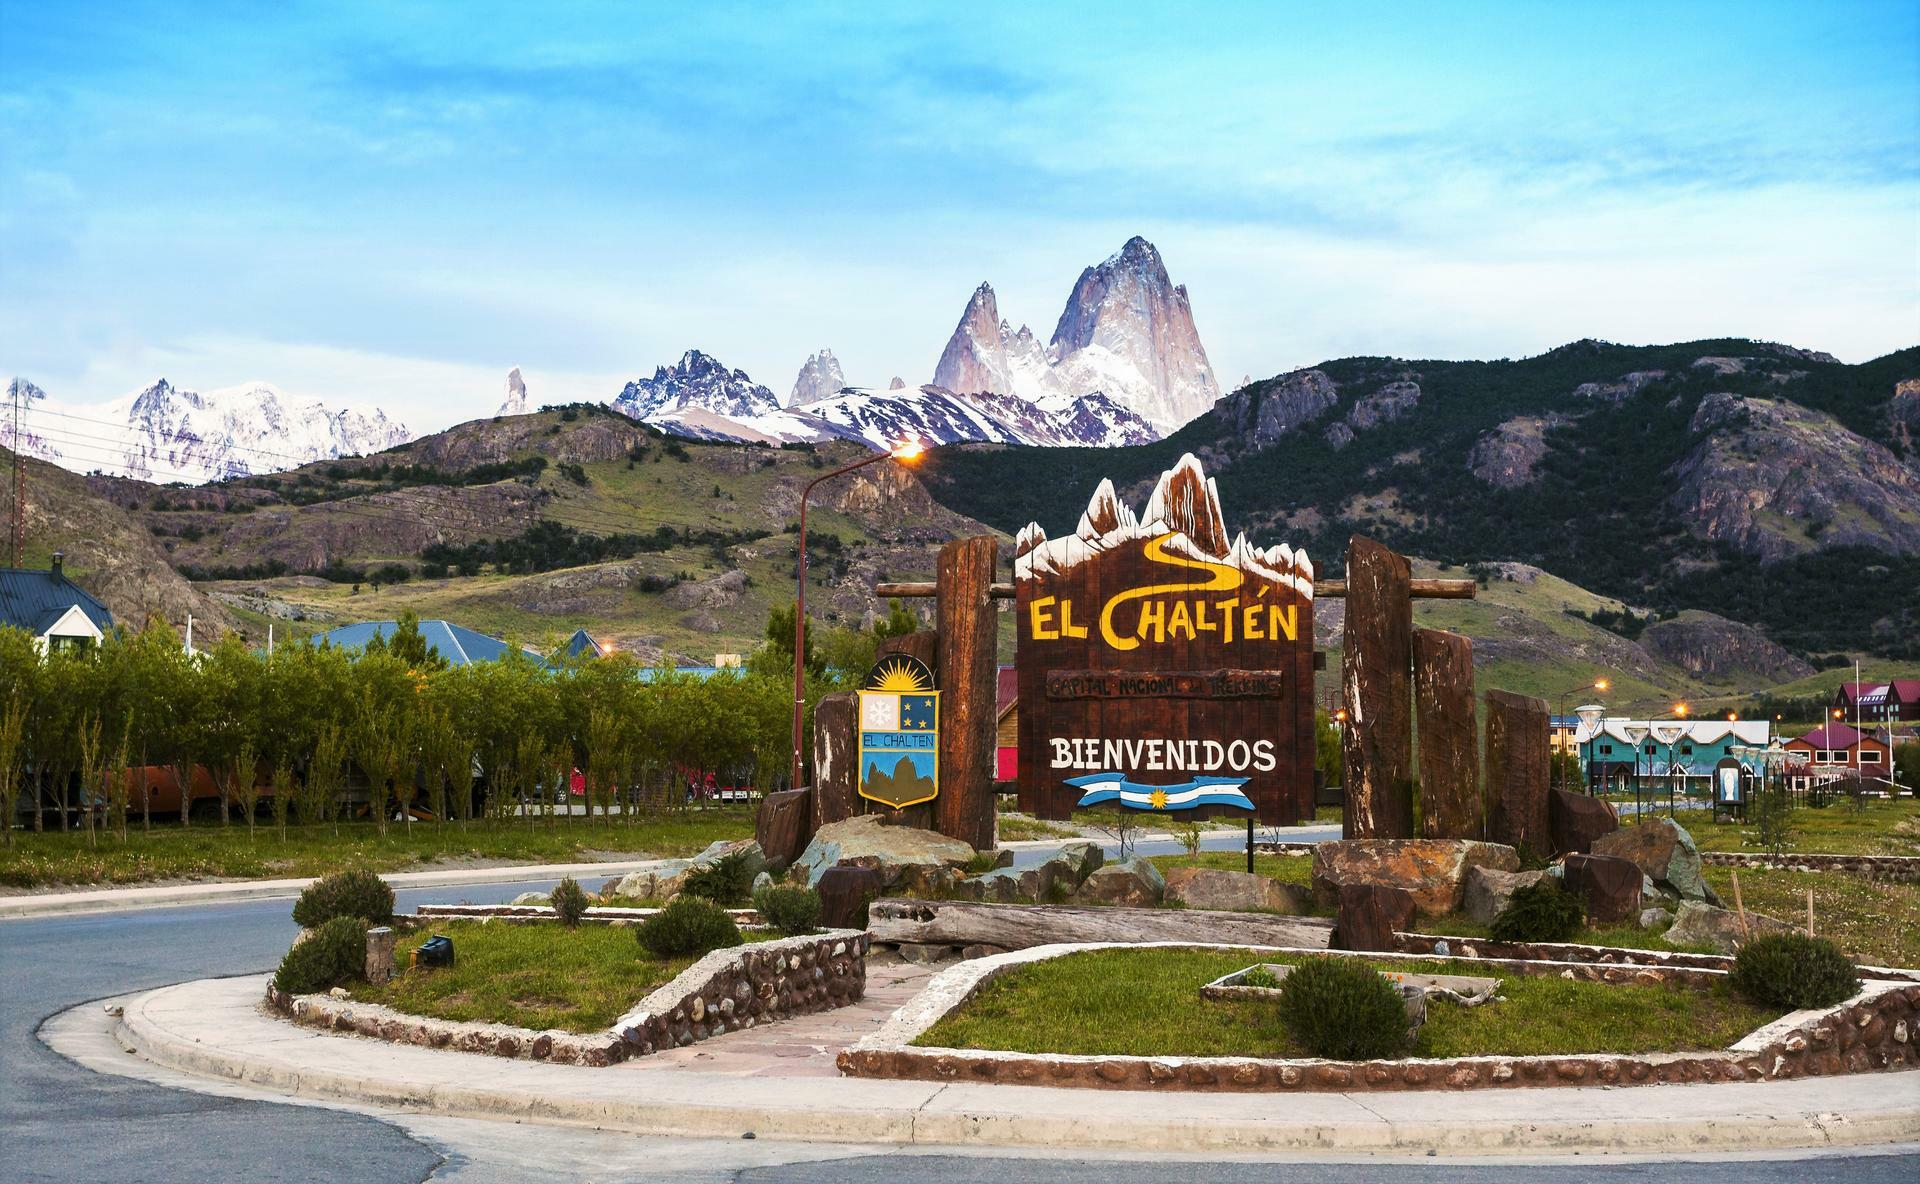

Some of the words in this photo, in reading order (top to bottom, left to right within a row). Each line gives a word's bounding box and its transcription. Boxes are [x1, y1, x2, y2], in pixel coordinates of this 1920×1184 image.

[1029, 596, 1088, 640] EL
[1100, 585, 1298, 651] CHALTÉN
[1049, 678, 1110, 695] CAPITAL
[1118, 679, 1182, 694] NACIONAL
[863, 735, 877, 746] EL
[1049, 737, 1277, 771] BIENVENIDOS
